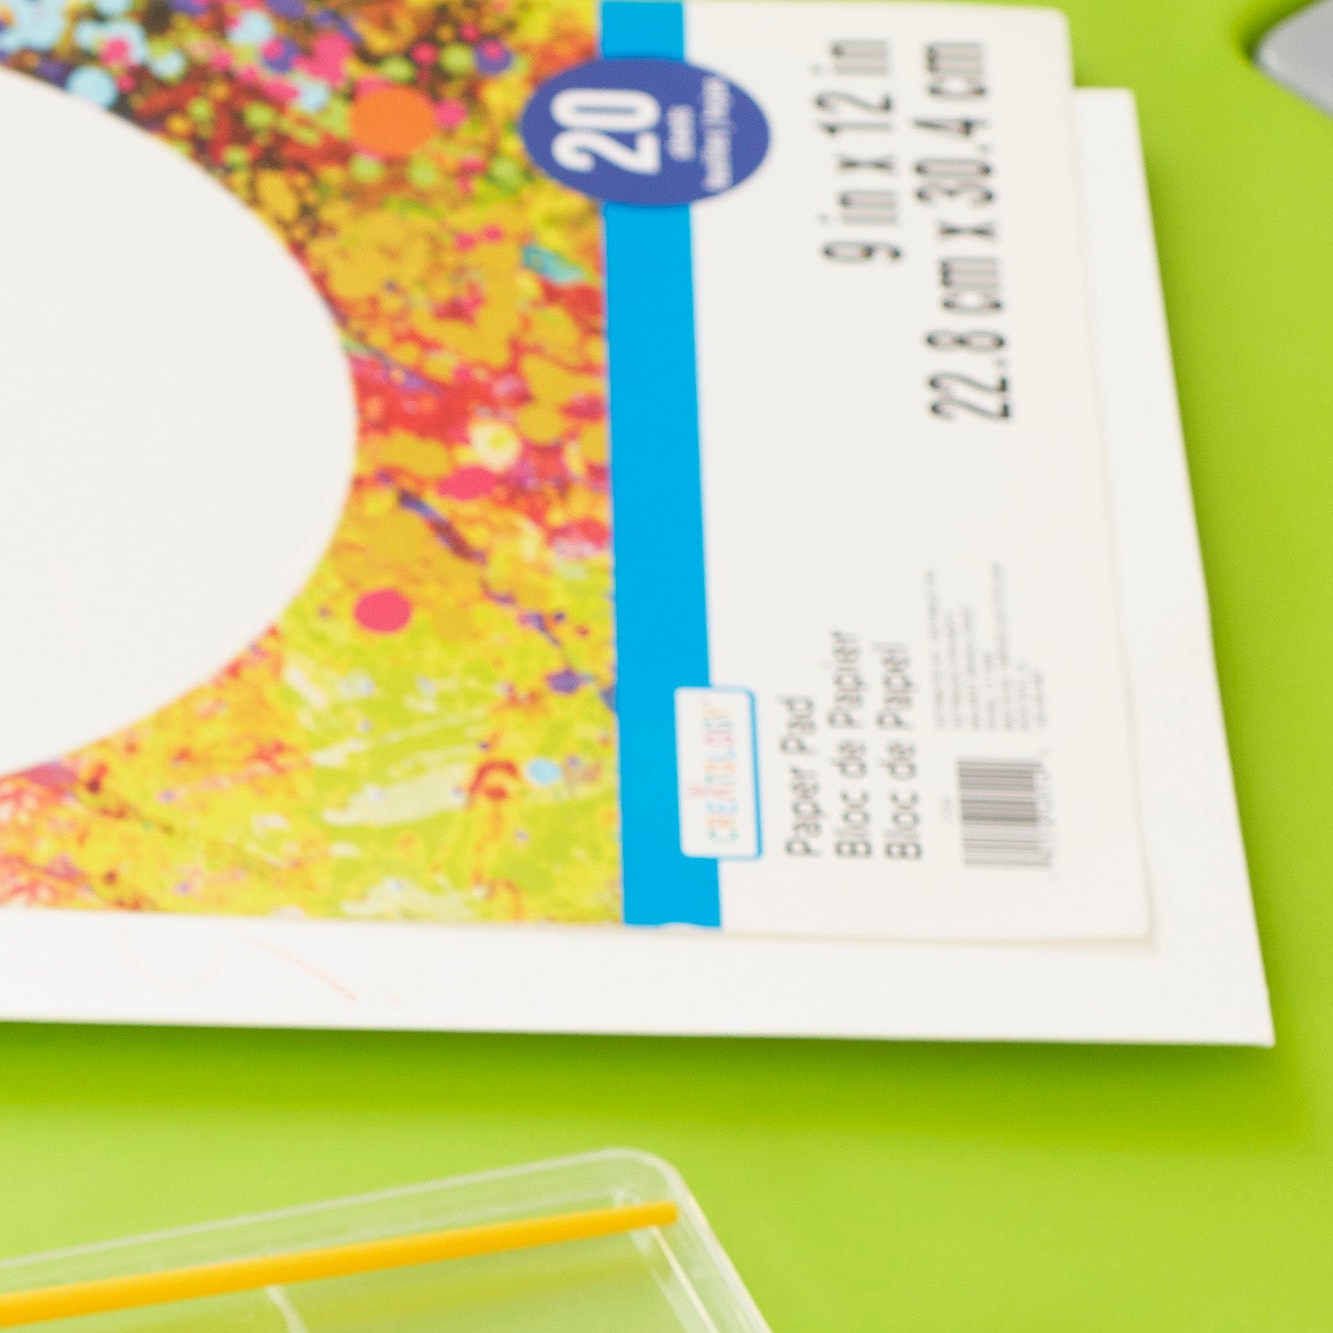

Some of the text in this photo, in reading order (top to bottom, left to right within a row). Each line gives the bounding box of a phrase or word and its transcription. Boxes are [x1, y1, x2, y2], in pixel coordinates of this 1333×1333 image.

[550, 88, 661, 176] 20
[807, 39, 903, 264] 9 in x 12 in
[911, 41, 1013, 422] 22.8 cm x 30.4 cm
[778, 694, 826, 858] Paper Pad
[821, 628, 874, 860] Bloc de Papier
[870, 640, 923, 861] Bloc de Papel
